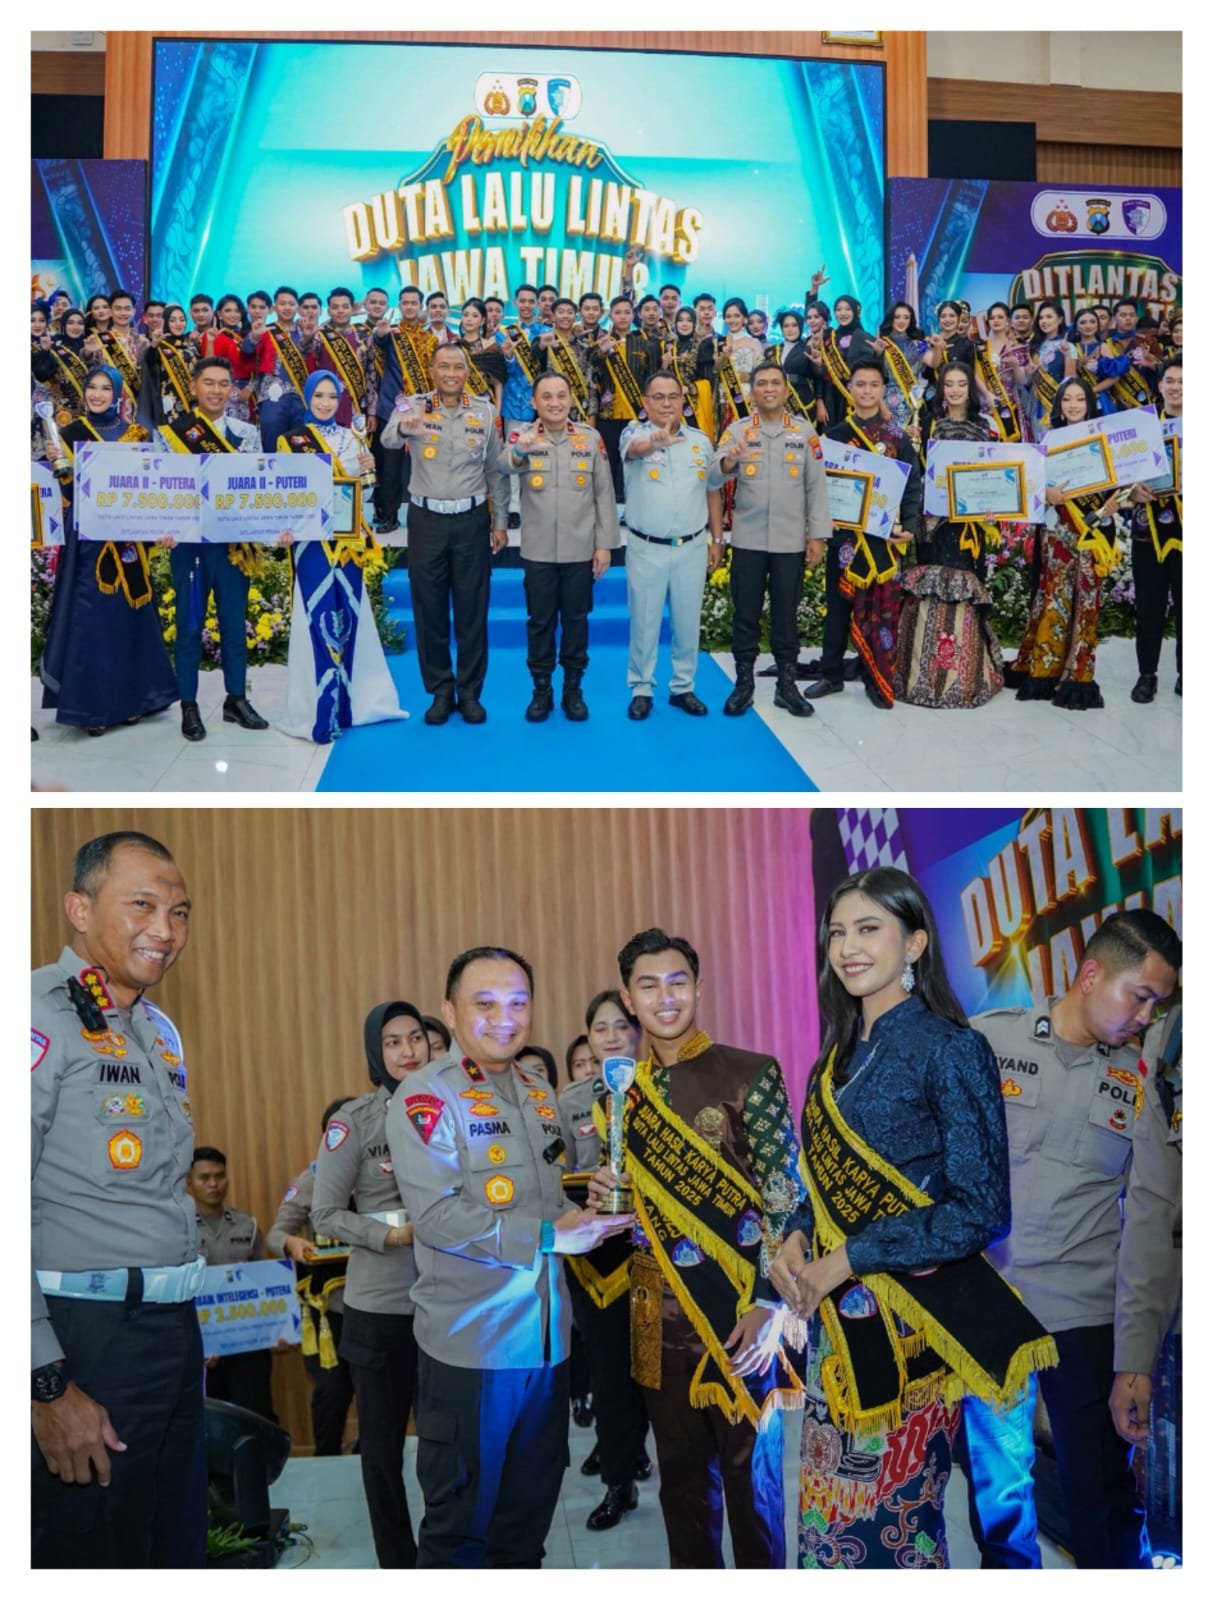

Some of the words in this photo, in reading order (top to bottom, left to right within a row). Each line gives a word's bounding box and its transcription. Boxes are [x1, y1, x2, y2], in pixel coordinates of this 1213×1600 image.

[344, 179, 454, 263] DUTA
[461, 171, 556, 233] LALU
[566, 174, 703, 265] LINTAS
[1021, 263, 1179, 302] DITLANTAS
[108, 475, 140, 489] JUARA
[159, 476, 196, 490] PUTERA
[227, 476, 257, 489] JUARA
[275, 475, 307, 488] PUTERI
[239, 491, 318, 509] 7.500.000
[960, 808, 1097, 967] DUTA
[99, 1063, 142, 1085] IWAN
[469, 1119, 512, 1138] PASMA
[643, 1146, 676, 1183] TAHUN
[674, 1180, 703, 1206] 2025
[683, 1149, 718, 1184] KARYA
[715, 1178, 748, 1211] PUTRA
[687, 1174, 713, 1199] JAWA
[842, 1156, 881, 1199] KARYA
[879, 1191, 911, 1217] PUT
[831, 1190, 861, 1223] 2025
[844, 1185, 873, 1214] JAWA
